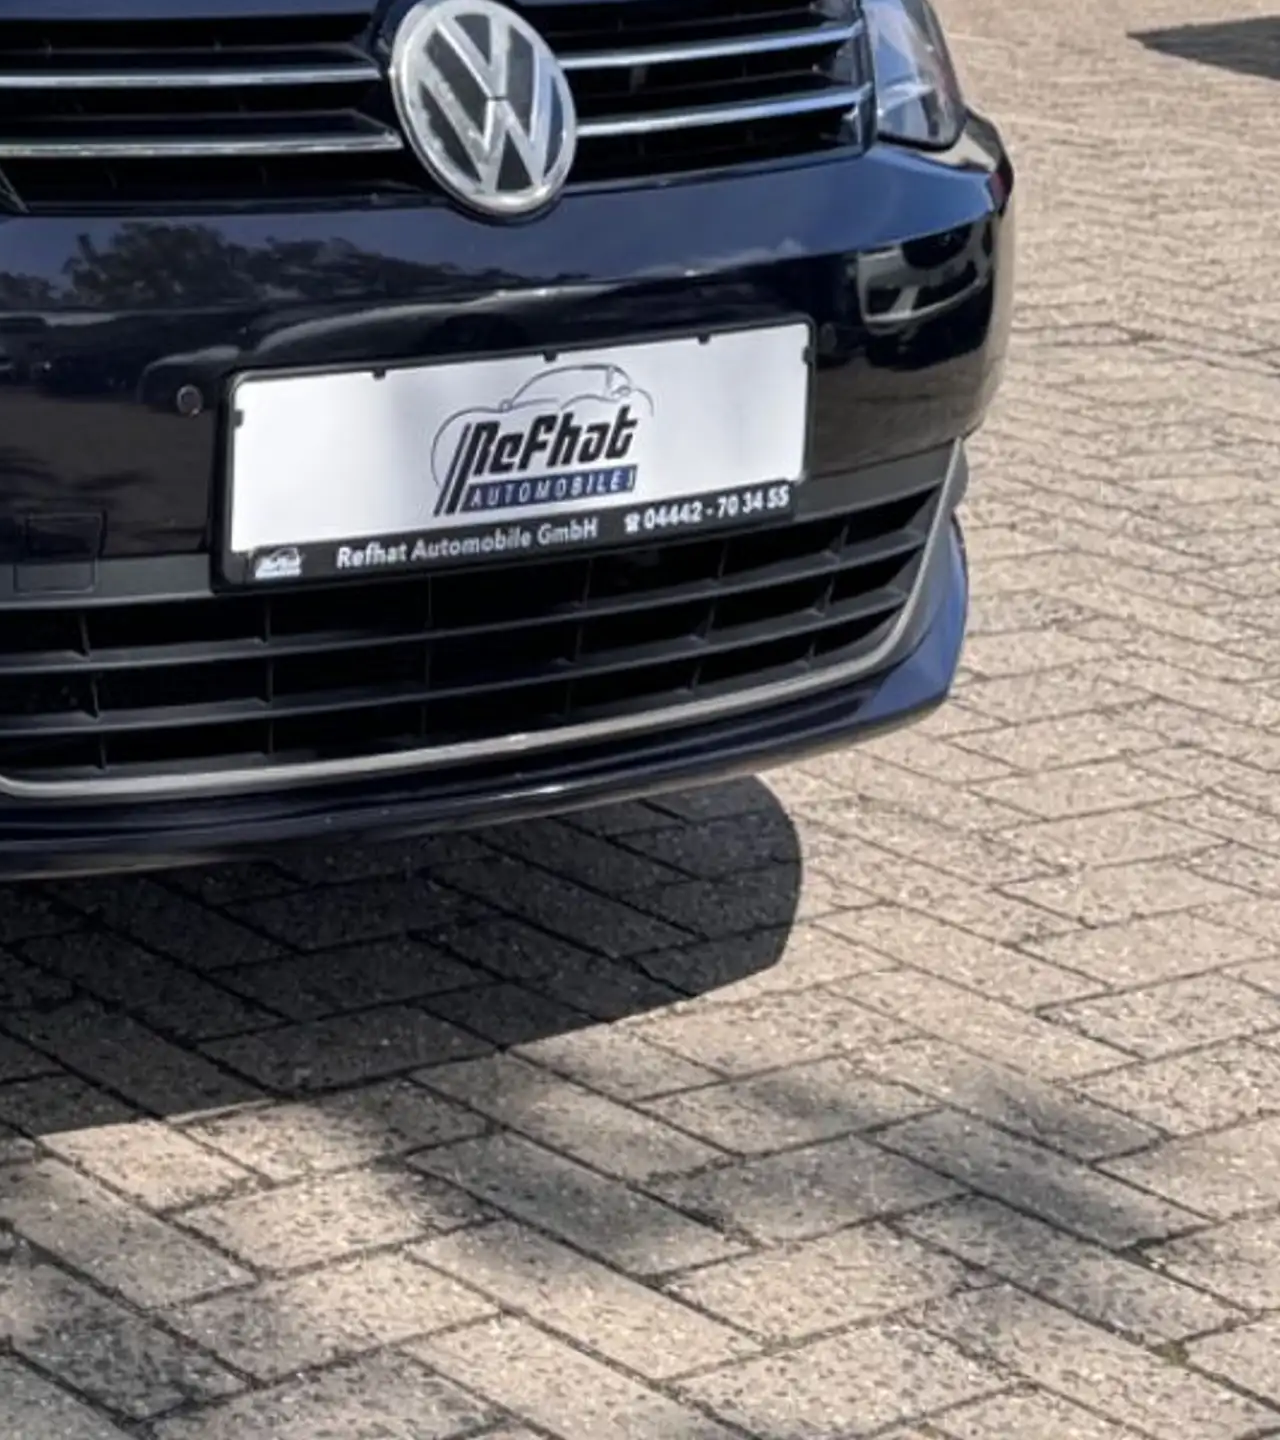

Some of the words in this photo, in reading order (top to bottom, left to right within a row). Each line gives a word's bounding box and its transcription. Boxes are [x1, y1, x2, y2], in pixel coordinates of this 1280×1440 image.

[434, 405, 638, 517] Refhat
[469, 471, 624, 508] AUTOMOBILE
[643, 500, 703, 531] 04442
[716, 494, 739, 519] 70
[742, 490, 764, 515] 34
[767, 484, 790, 510] 55
[336, 539, 408, 570] Refhat
[411, 526, 532, 562] Automobile
[537, 516, 600, 545] GmbH
